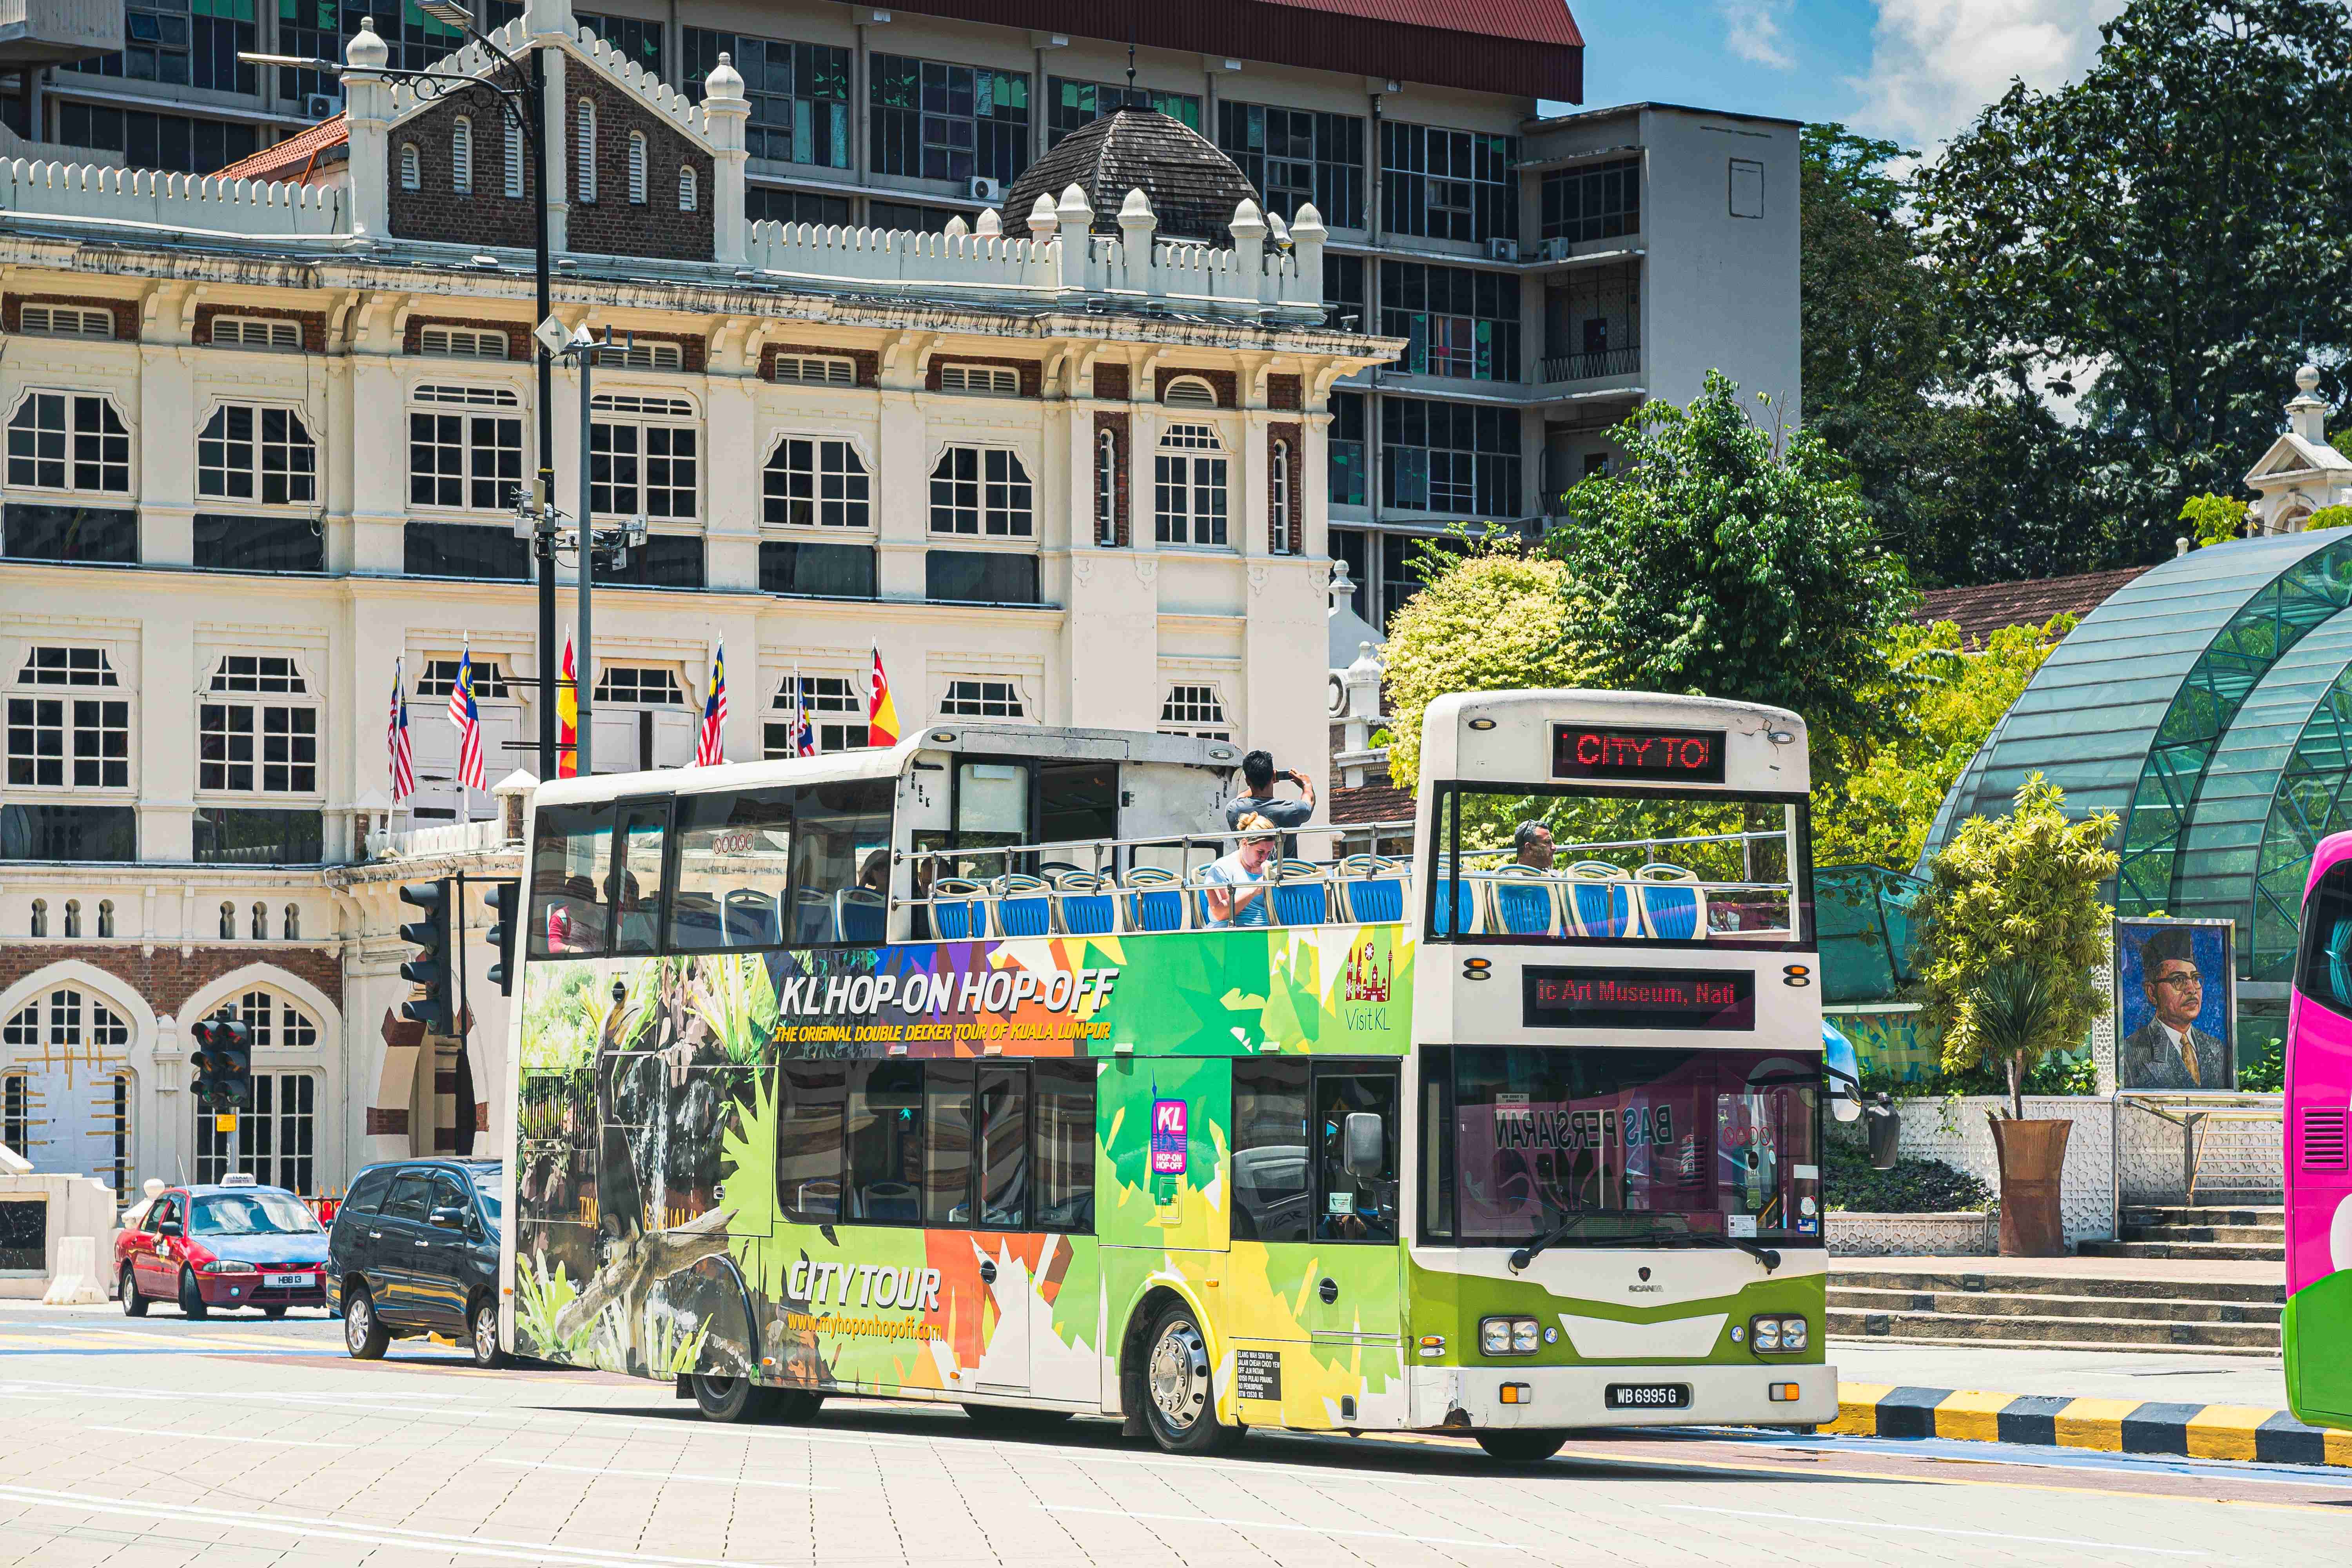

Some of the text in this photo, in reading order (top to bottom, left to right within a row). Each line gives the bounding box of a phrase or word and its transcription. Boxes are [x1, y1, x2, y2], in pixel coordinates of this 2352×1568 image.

[1577, 734, 1653, 766] CITY
[958, 968, 1120, 1014] HOP-OFF
[1562, 979, 1592, 1001] Art
[1599, 981, 1688, 1006] Museum,
[1696, 982, 1735, 1004] Nati
[775, 1022, 1111, 1042] THE ORIGINAL DOUBLE DECKER TOUR OF KUALA LUMPUR
[1158, 1107, 1183, 1131] KL
[1156, 1153, 1182, 1161] HOP-ON
[1156, 1161, 1182, 1170] HOP-OFF
[788, 1260, 941, 1312] CITY TOUR
[788, 1311, 943, 1343] www.myhoponhopoff.com
[1617, 1388, 1676, 1403] WB 6995 G
